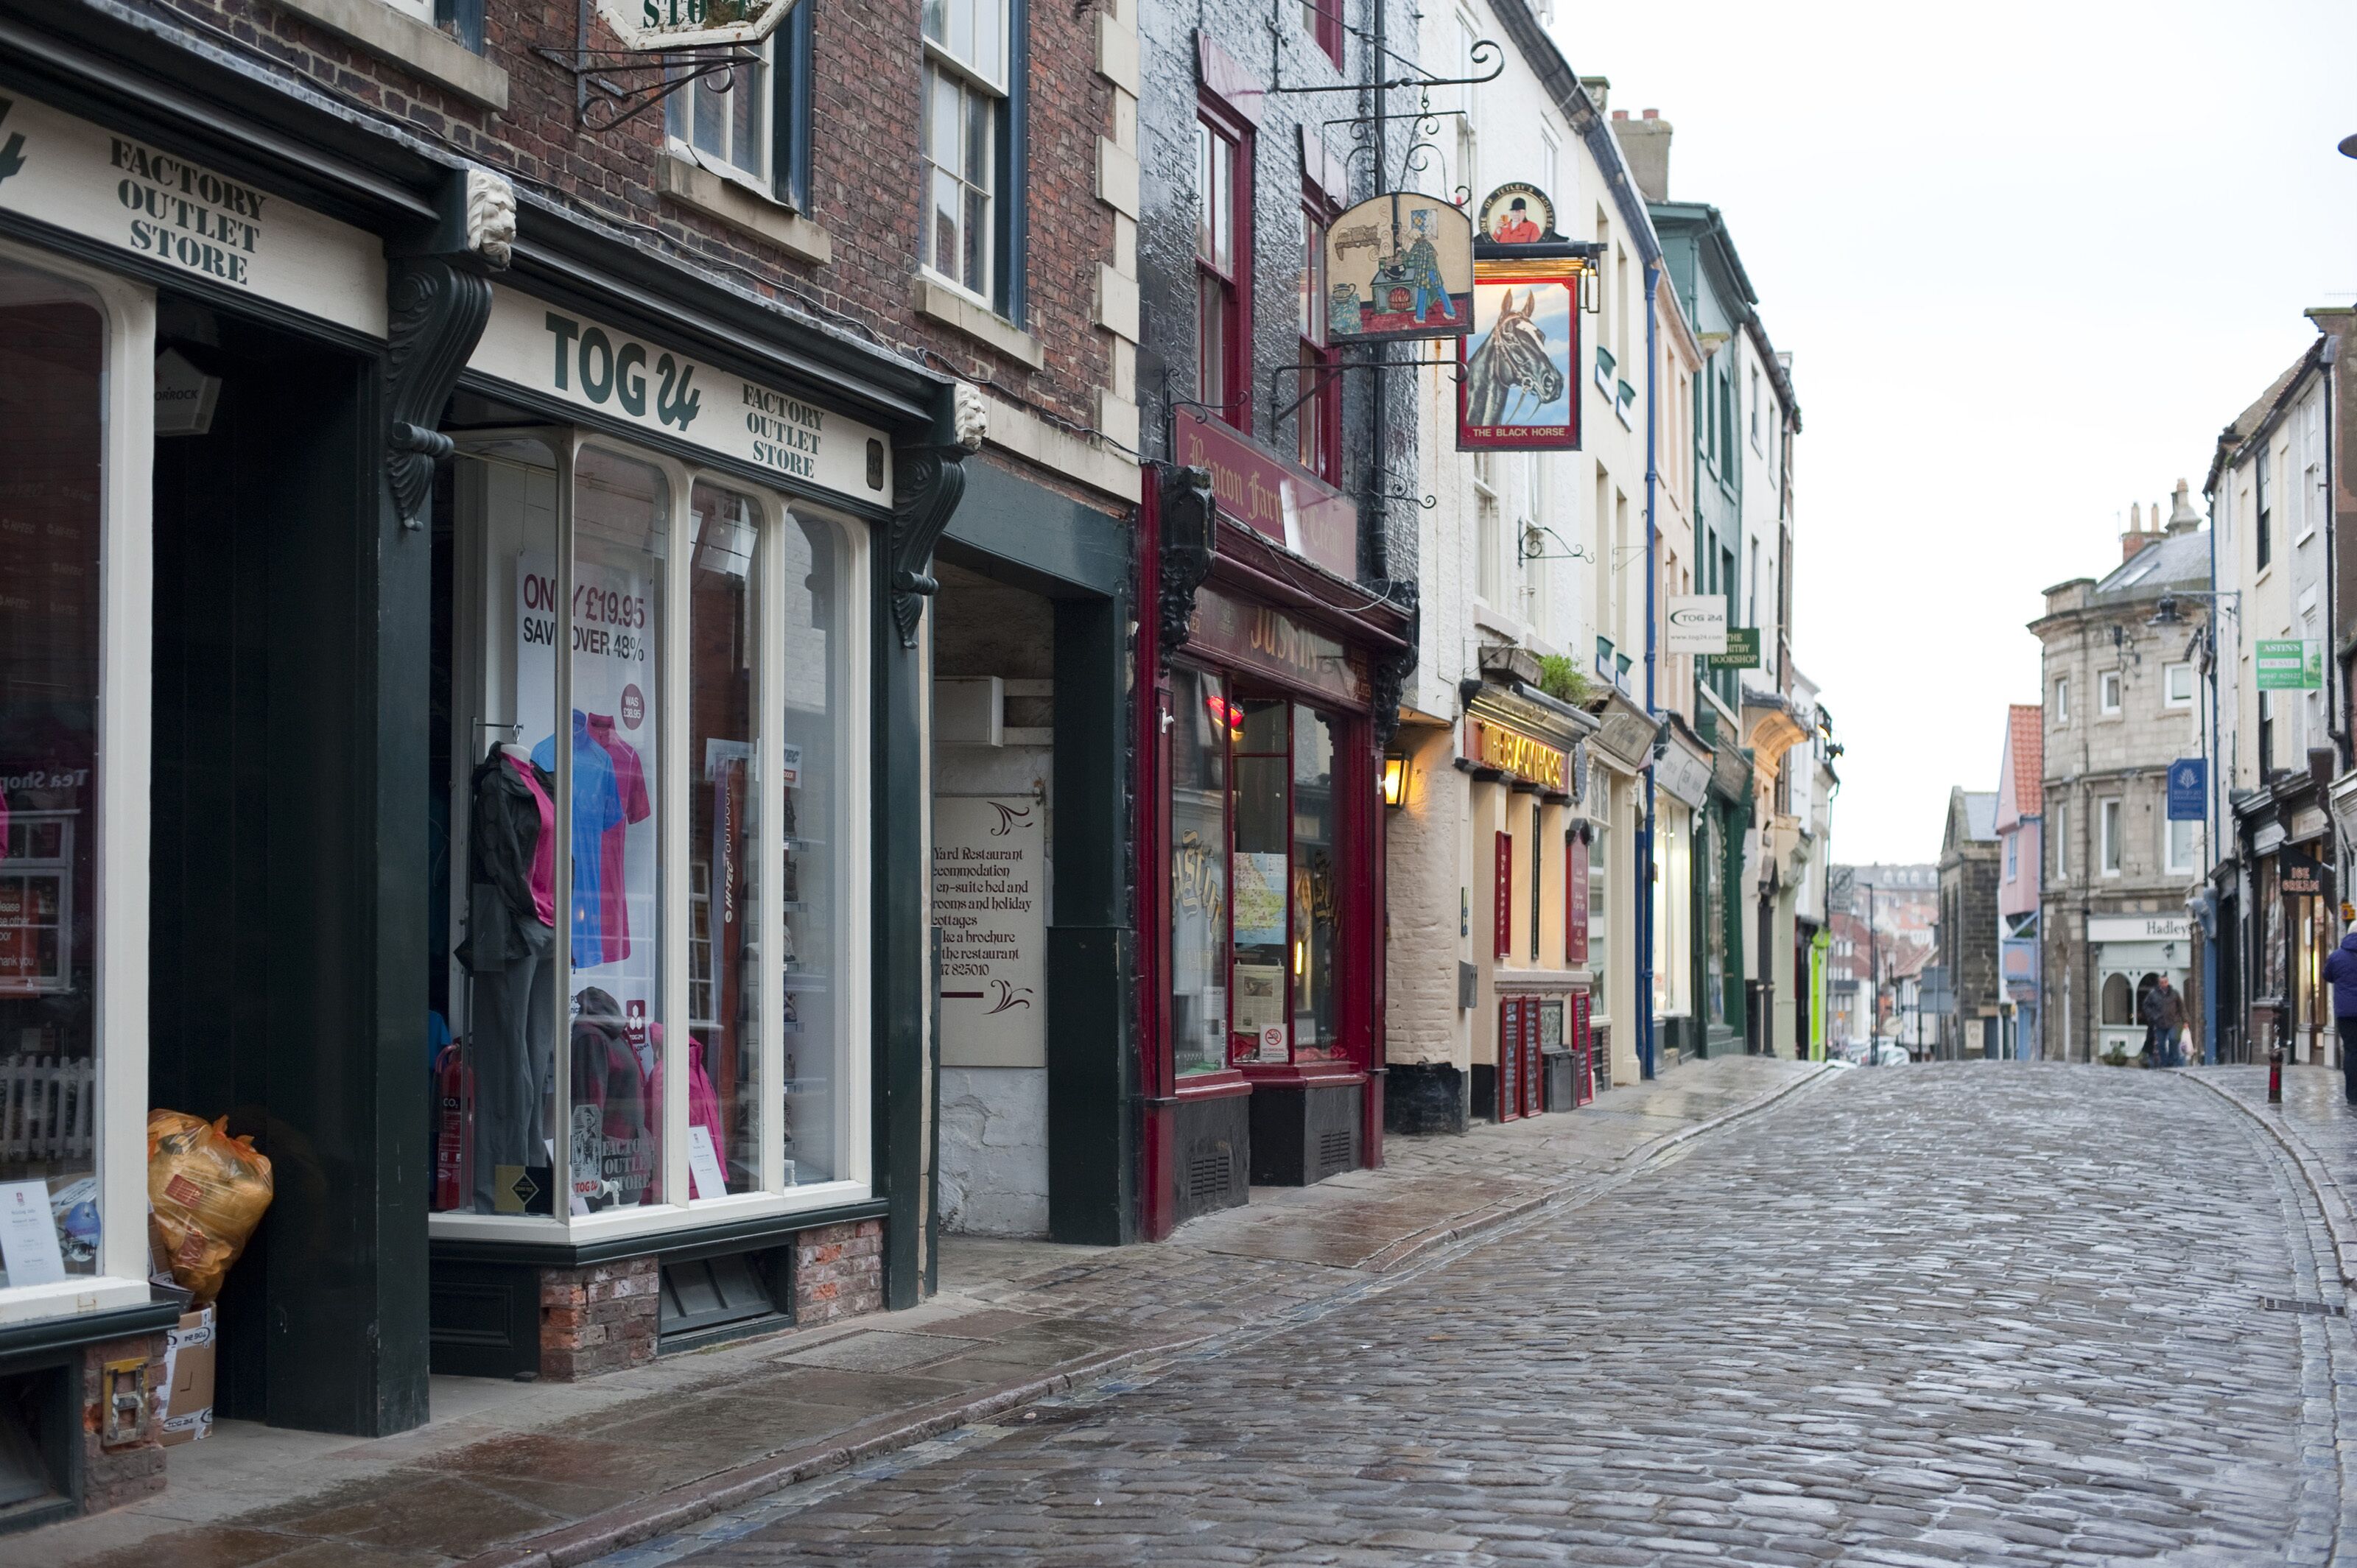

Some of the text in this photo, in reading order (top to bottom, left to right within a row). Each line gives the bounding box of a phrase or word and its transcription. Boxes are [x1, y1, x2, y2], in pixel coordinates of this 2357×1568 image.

[110, 136, 267, 222] FACTORY
[118, 178, 260, 254] OUTLET
[130, 219, 248, 285] STORE
[546, 311, 647, 418] TOG
[742, 382, 825, 432] FACTORY
[746, 412, 821, 456] OUTLET
[1472, 428, 1566, 437] THE BLACK HORSE
[752, 440, 815, 479] STORE
[524, 574, 645, 630] ONY £19.95
[1681, 614, 1705, 622] TOG
[613, 635, 644, 661] 48%
[1710, 655, 1757, 664] BOOKSHOP
[625, 696, 639, 707] WAS
[934, 846, 1024, 862] Yard Restaurant
[2291, 867, 2310, 879] ICE
[936, 879, 1028, 895] en-suite bed and
[2282, 879, 2320, 892] CREAM
[969, 897, 989, 911] and
[992, 896, 1032, 913] holiday
[957, 933, 963, 943] a
[966, 929, 1016, 944] brochure
[942, 946, 1019, 961] the restaurant
[952, 964, 989, 976] 825010
[575, 1181, 591, 1193] TOG
